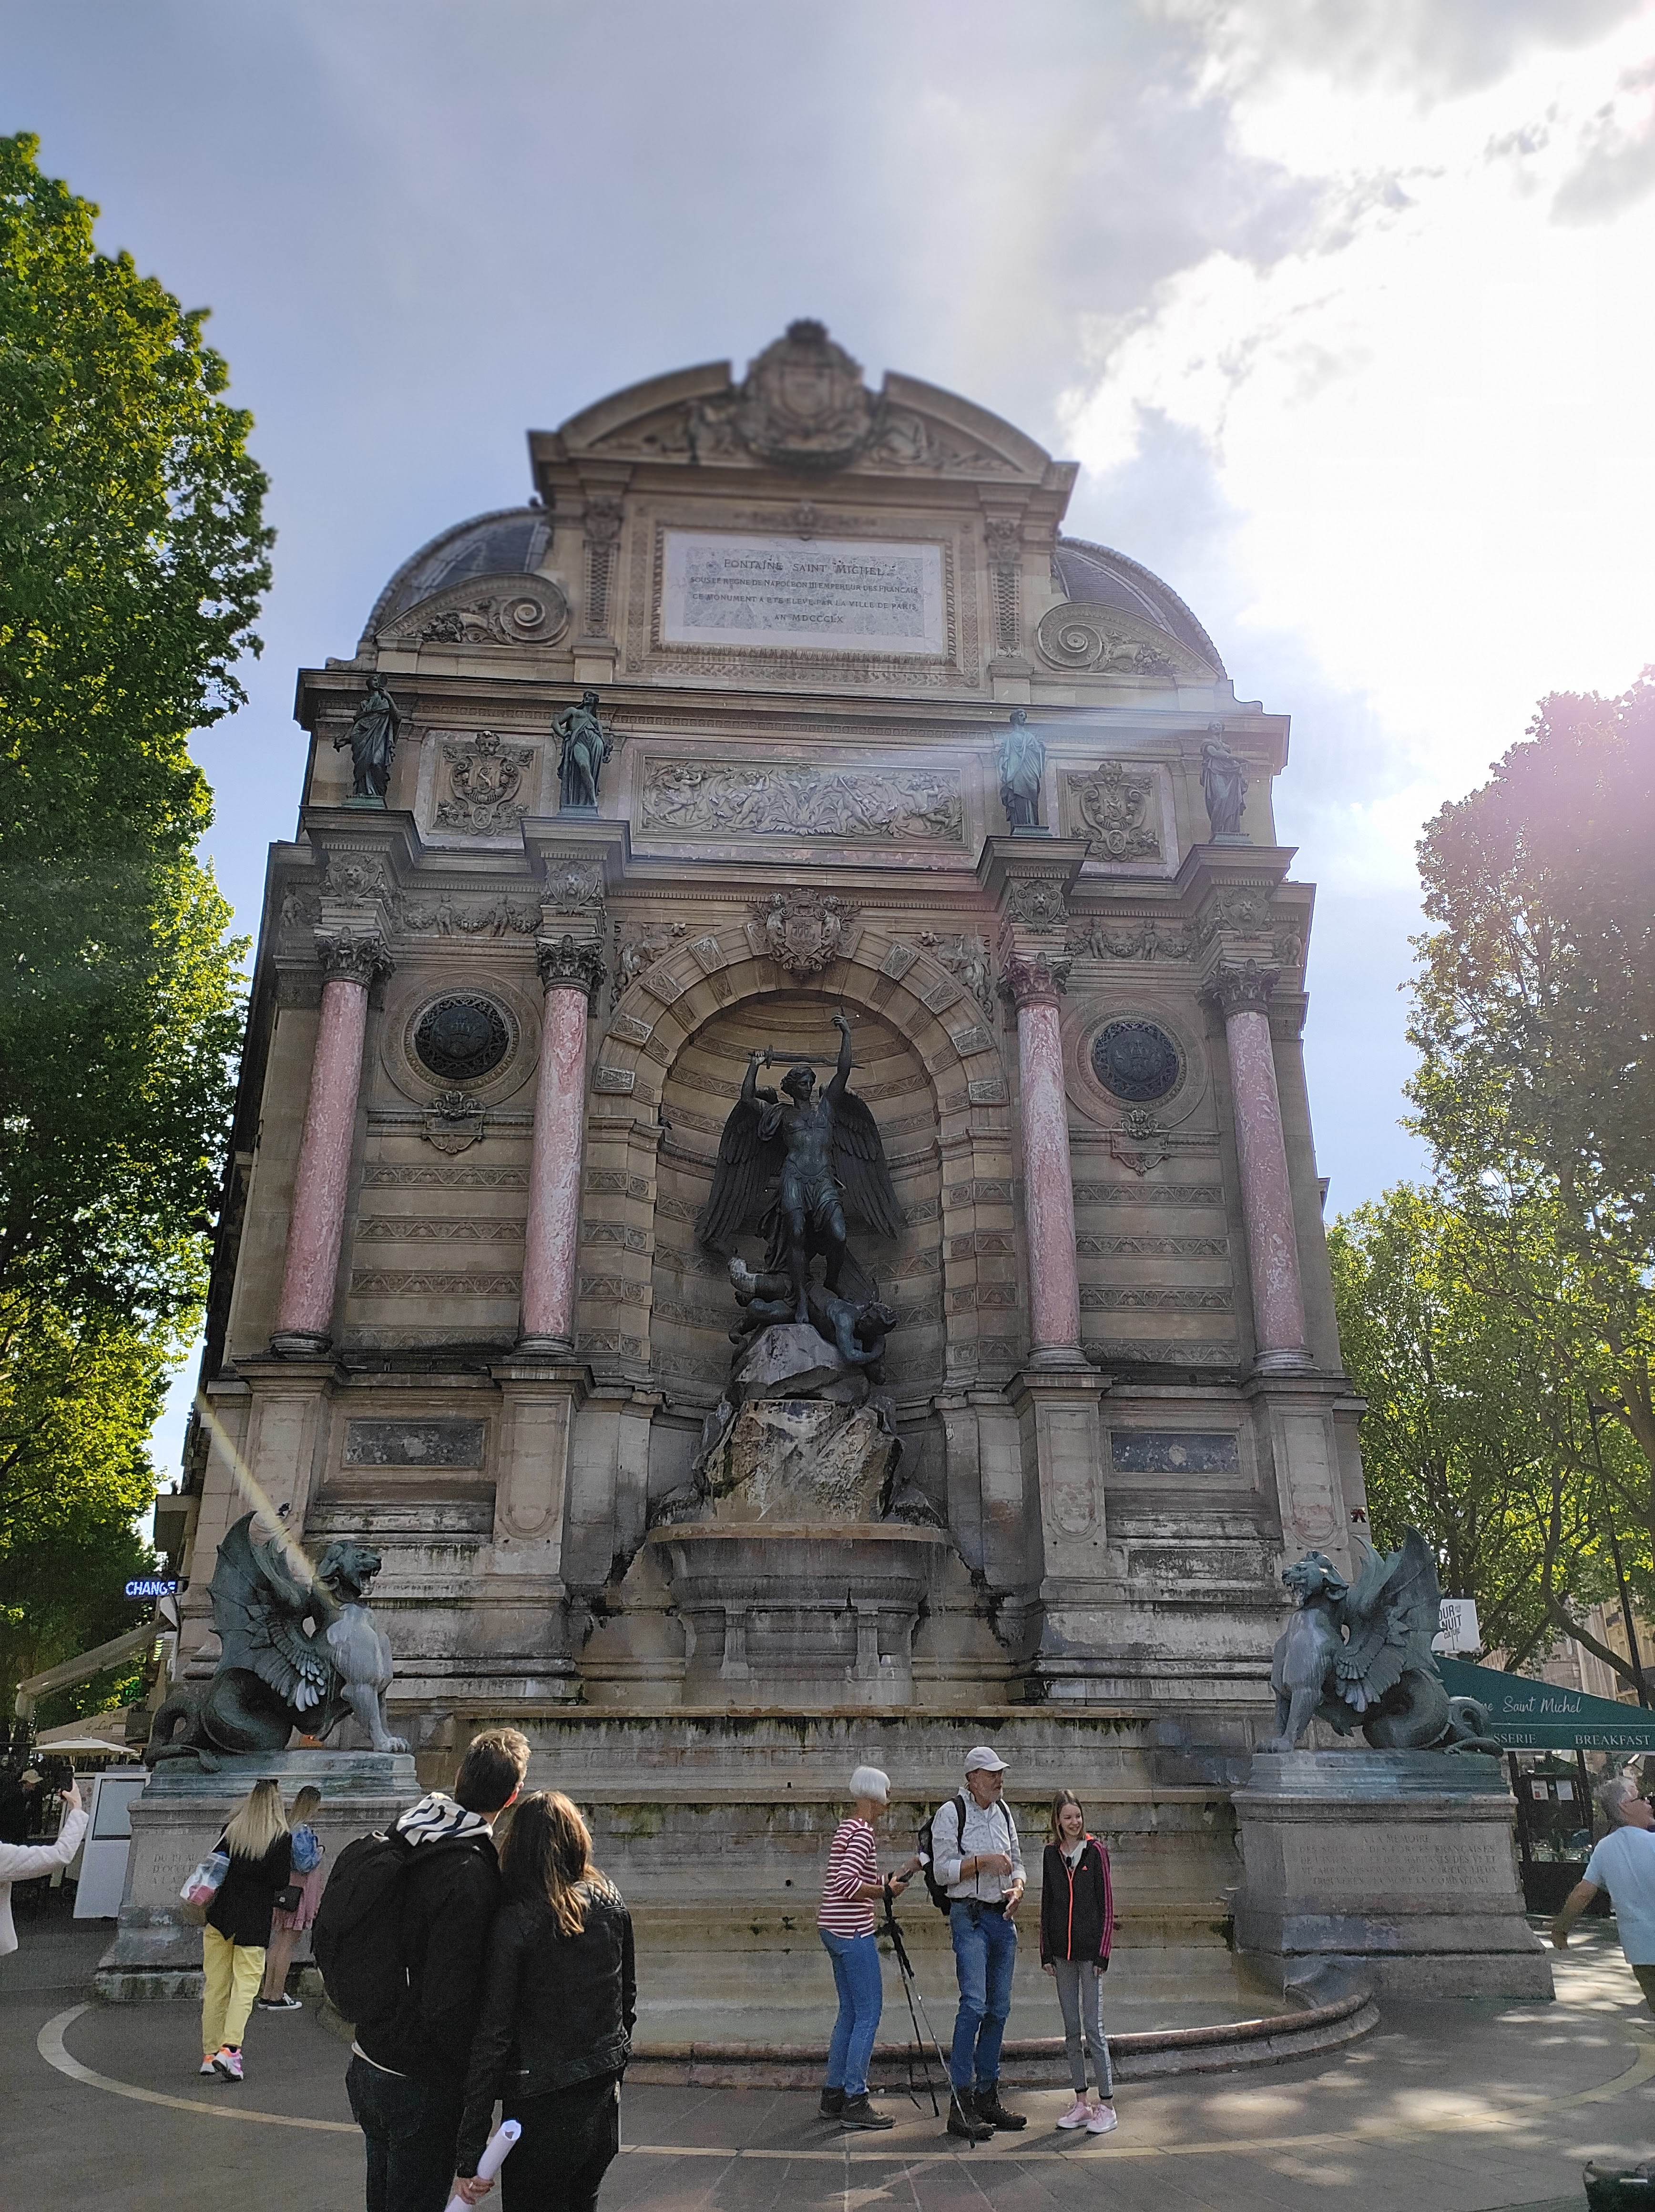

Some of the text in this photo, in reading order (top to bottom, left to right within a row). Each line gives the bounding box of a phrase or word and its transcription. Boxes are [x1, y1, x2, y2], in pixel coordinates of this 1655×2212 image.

[724, 559, 885, 576] FONTAINE SAINT MICHEL
[764, 580, 807, 588] NAPOLEON
[819, 583, 861, 591] EMPEREUR
[706, 594, 757, 603] MONUMENT
[792, 615, 844, 623] MDCCCLX
[125, 1581, 176, 1596] CHANGE
[1439, 1605, 1455, 1621] OUR
[1441, 1614, 1461, 1631] NUIT
[1503, 1696, 1536, 1713] Saint
[1540, 1695, 1583, 1713] Michel
[1493, 1733, 1537, 1744] SSERIE
[1575, 1734, 1651, 1746] BREAKFAST
